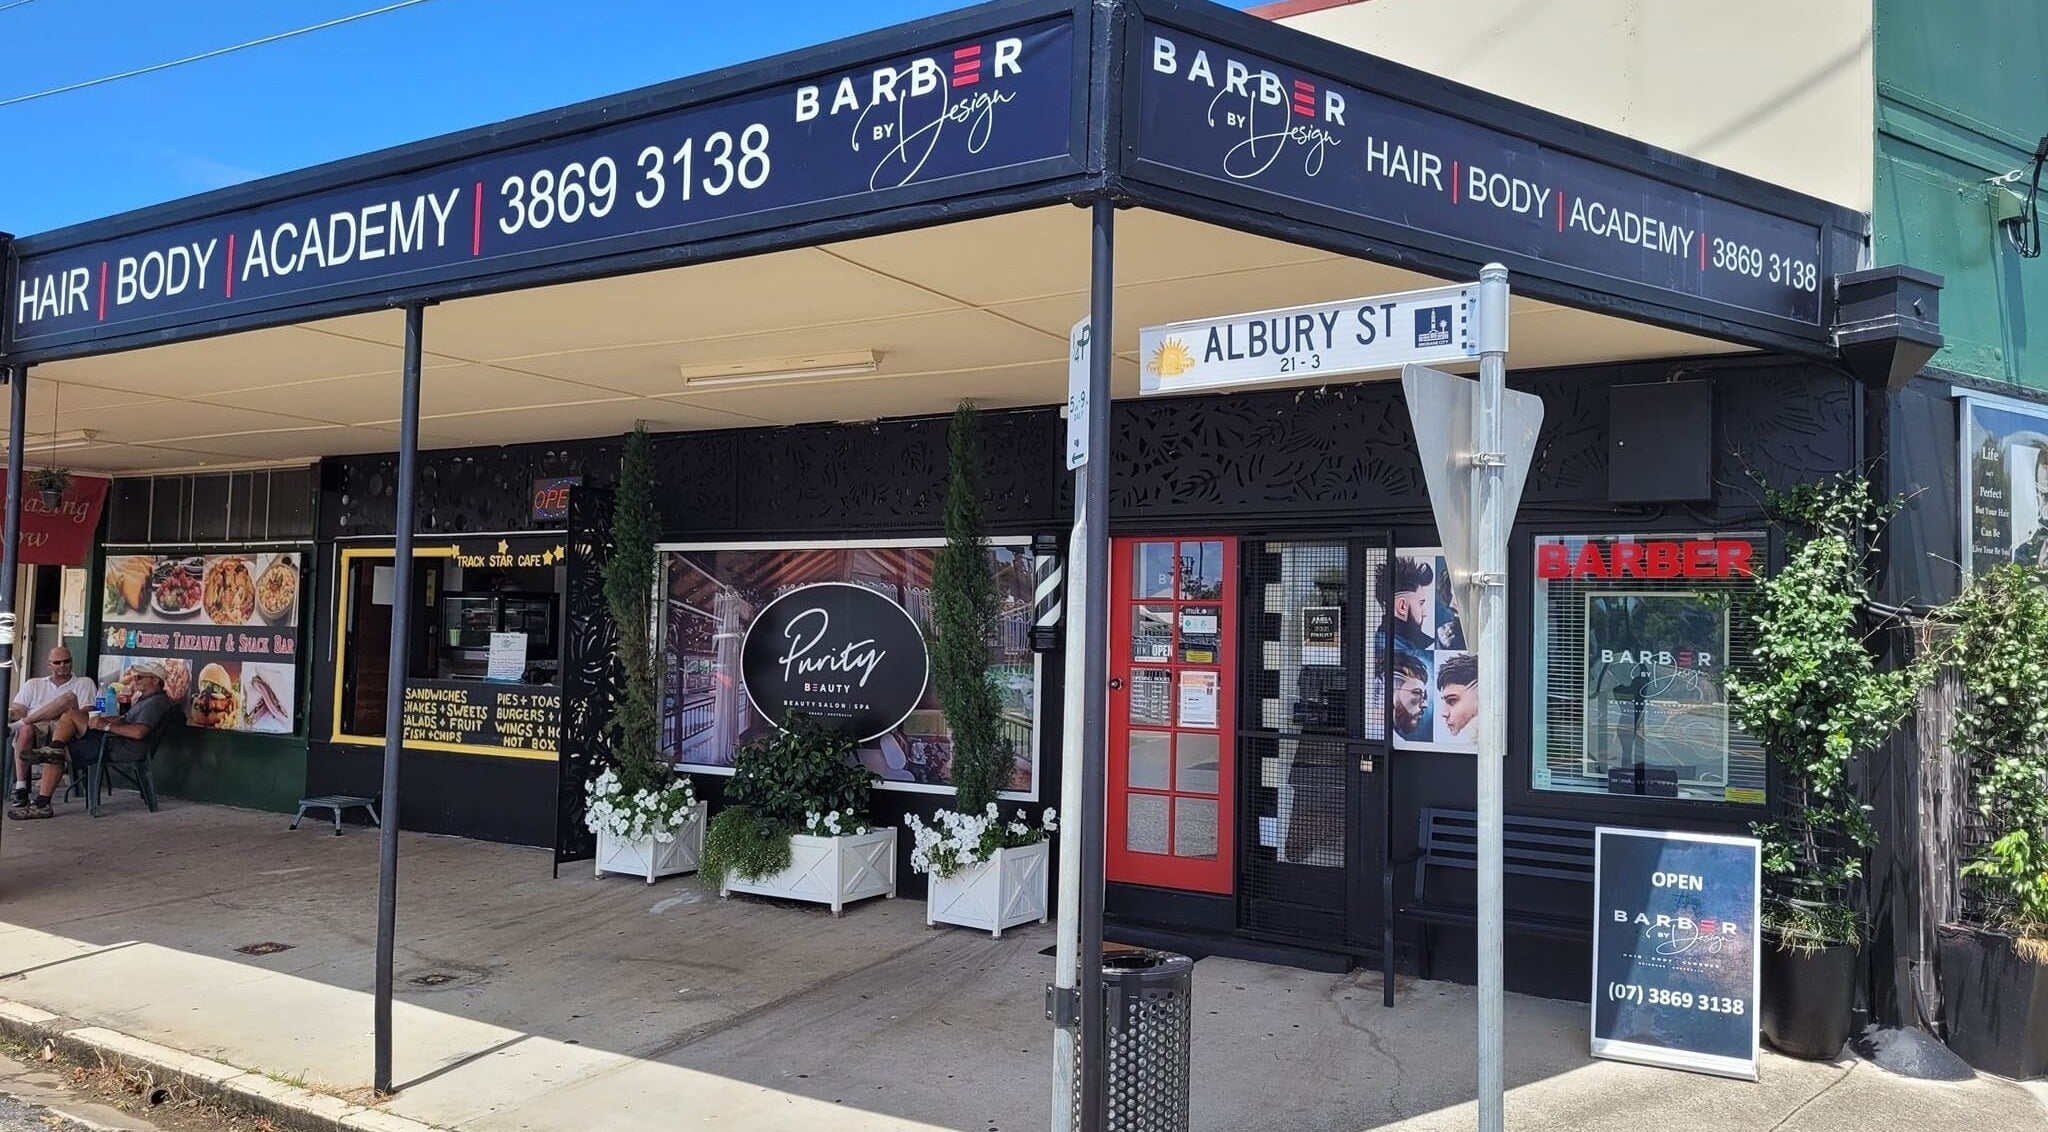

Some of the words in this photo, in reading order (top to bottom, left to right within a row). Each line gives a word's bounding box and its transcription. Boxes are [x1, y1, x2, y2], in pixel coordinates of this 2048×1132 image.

[796, 37, 1023, 123] BARBER
[1153, 36, 1345, 126] BARBER
[852, 64, 1016, 192] Design
[1208, 74, 1341, 178] Design
[1227, 112, 1246, 128] BY
[873, 122, 895, 141] BY
[1367, 136, 1443, 191] HAIR
[1469, 166, 1550, 219] BODY
[1570, 198, 1694, 259] ACADEMY
[1713, 238, 1763, 277] 3869
[1769, 253, 1816, 292] 3138
[18, 266, 90, 324] HAIR
[116, 238, 218, 305] BODY
[242, 188, 460, 282] ACADEMY
[499, 156, 617, 235] 3869
[635, 123, 771, 210] 3138
[1204, 310, 1340, 363] ALBURY
[1356, 303, 1397, 345] ST
[1280, 357, 1295, 372] 21
[1312, 354, 1321, 369] 3
[1982, 446, 1999, 462] Life
[534, 488, 570, 509] OPE
[1980, 486, 2002, 500] Perfect
[1981, 527, 1992, 537] Can
[457, 555, 485, 568] TRACK
[489, 555, 513, 567] STAR
[517, 554, 541, 567] CAFE
[1537, 541, 1753, 579] BARBER
[137, 630, 170, 650] CHINESE
[173, 631, 223, 652] TAKEAWAY
[225, 634, 235, 652] &
[239, 633, 270, 654] SNACK
[274, 634, 295, 655] BAR
[779, 608, 886, 688] Purity
[1152, 644, 1172, 657] OPEN
[1601, 649, 1711, 667] BARBER
[405, 687, 468, 704] SANDWICHES
[804, 683, 851, 693] BEAUTY
[497, 693, 518, 706] PIES
[531, 695, 560, 709] TOAS
[784, 700, 816, 708] BEAUTY
[496, 707, 545, 723] BURGERS
[403, 727, 426, 740] FISH
[450, 718, 483, 732] FRUIT
[495, 721, 533, 737] WINGS
[503, 736, 523, 748] HOT
[531, 737, 557, 751] BOX
[1651, 872, 1703, 891] OPEN
[1614, 909, 1737, 935] BARBER
[1608, 982, 1644, 1005] (07)
[1649, 988, 1693, 1008] 3869
[1698, 995, 1744, 1015] 3138
